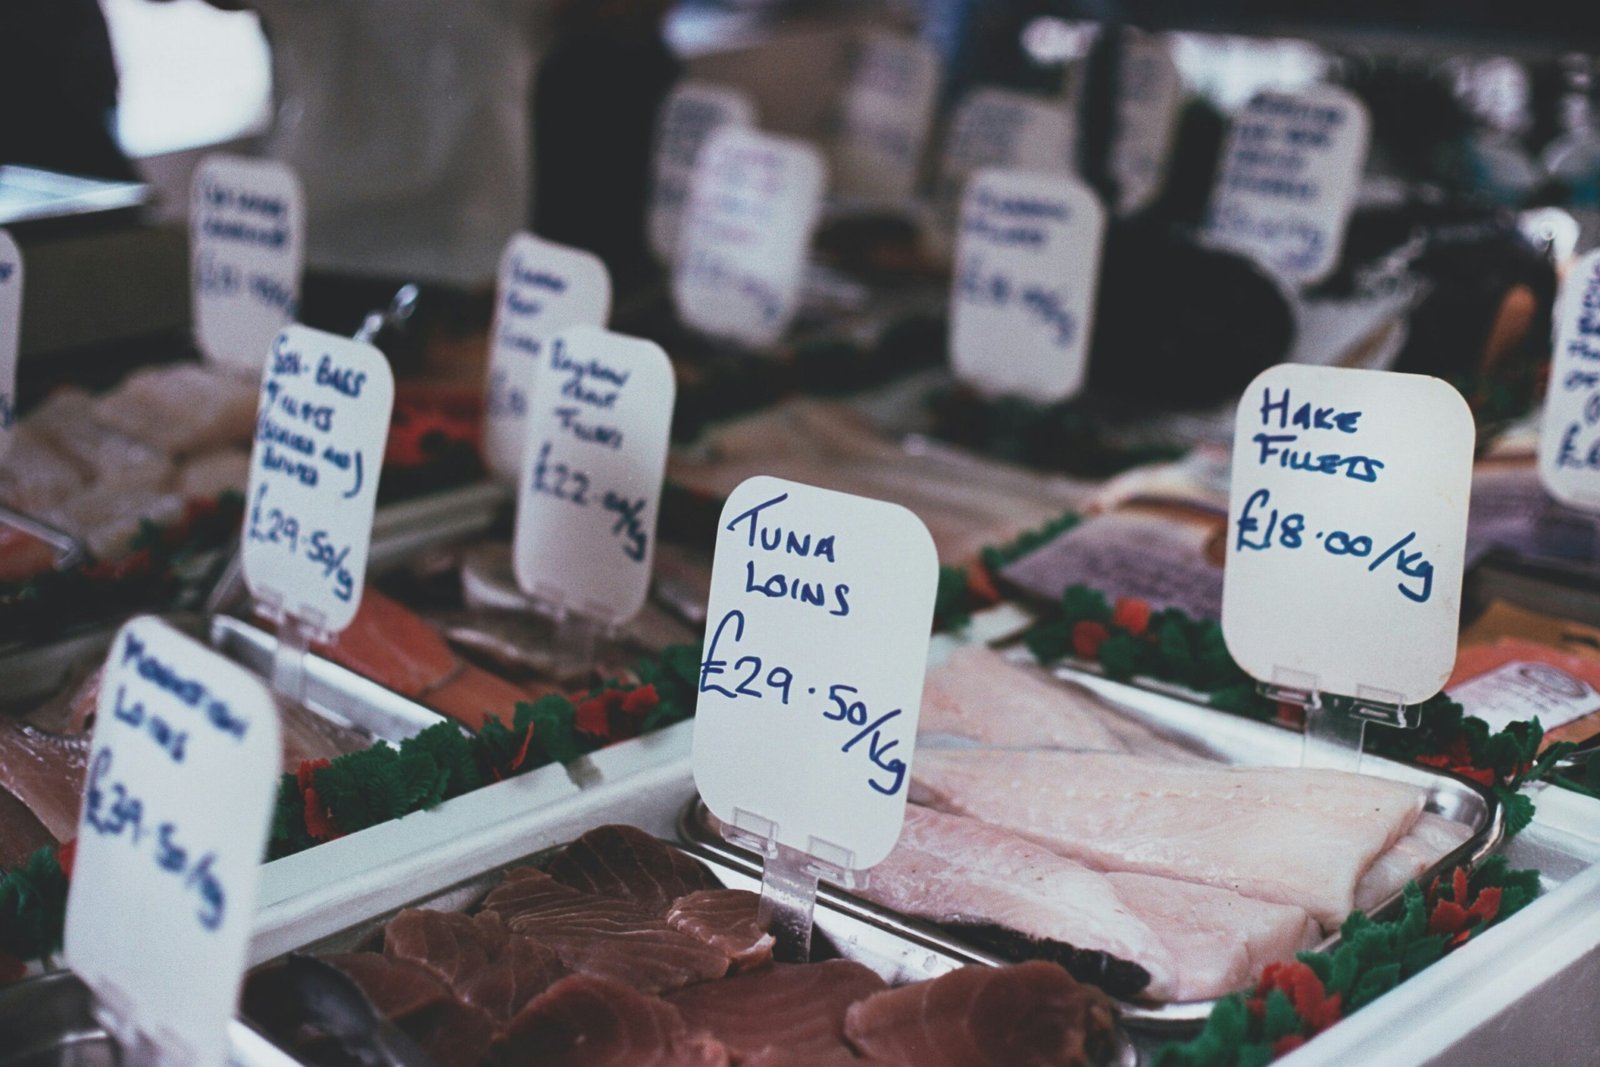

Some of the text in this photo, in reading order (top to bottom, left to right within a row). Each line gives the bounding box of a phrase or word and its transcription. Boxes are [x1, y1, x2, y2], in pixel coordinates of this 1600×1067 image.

[1260, 387, 1362, 434] HAKE
[1252, 433, 1385, 483] FILLETS
[726, 492, 836, 563] TUNA
[745, 560, 850, 617] LOINS
